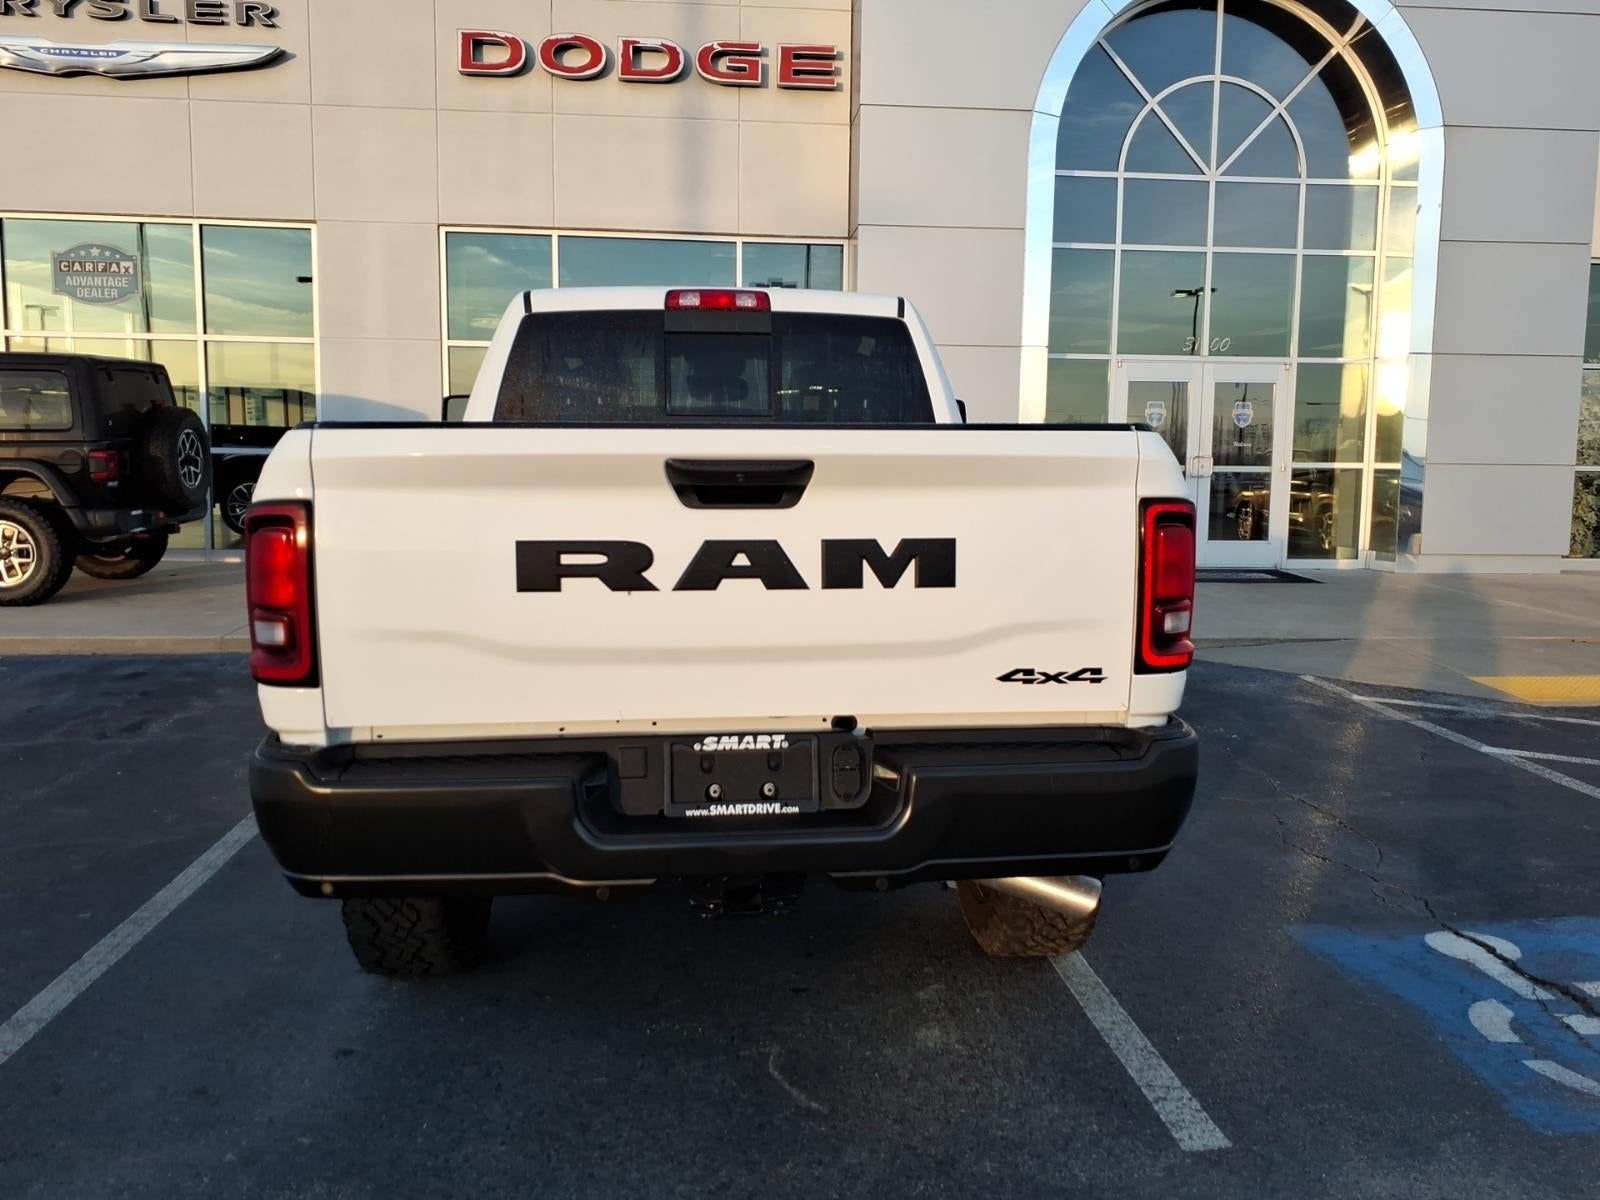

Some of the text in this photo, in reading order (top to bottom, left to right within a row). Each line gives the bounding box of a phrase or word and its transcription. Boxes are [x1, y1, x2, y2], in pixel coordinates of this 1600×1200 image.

[40, 48, 117, 57] CHRYSLER
[457, 29, 838, 89] DODGE
[59, 260, 133, 274] CARFAX
[65, 276, 129, 288] ADVANTAGE
[76, 287, 118, 299] DEALER
[516, 538, 956, 592] RAM
[995, 667, 1108, 685] 4x4
[702, 734, 786, 752] SMART
